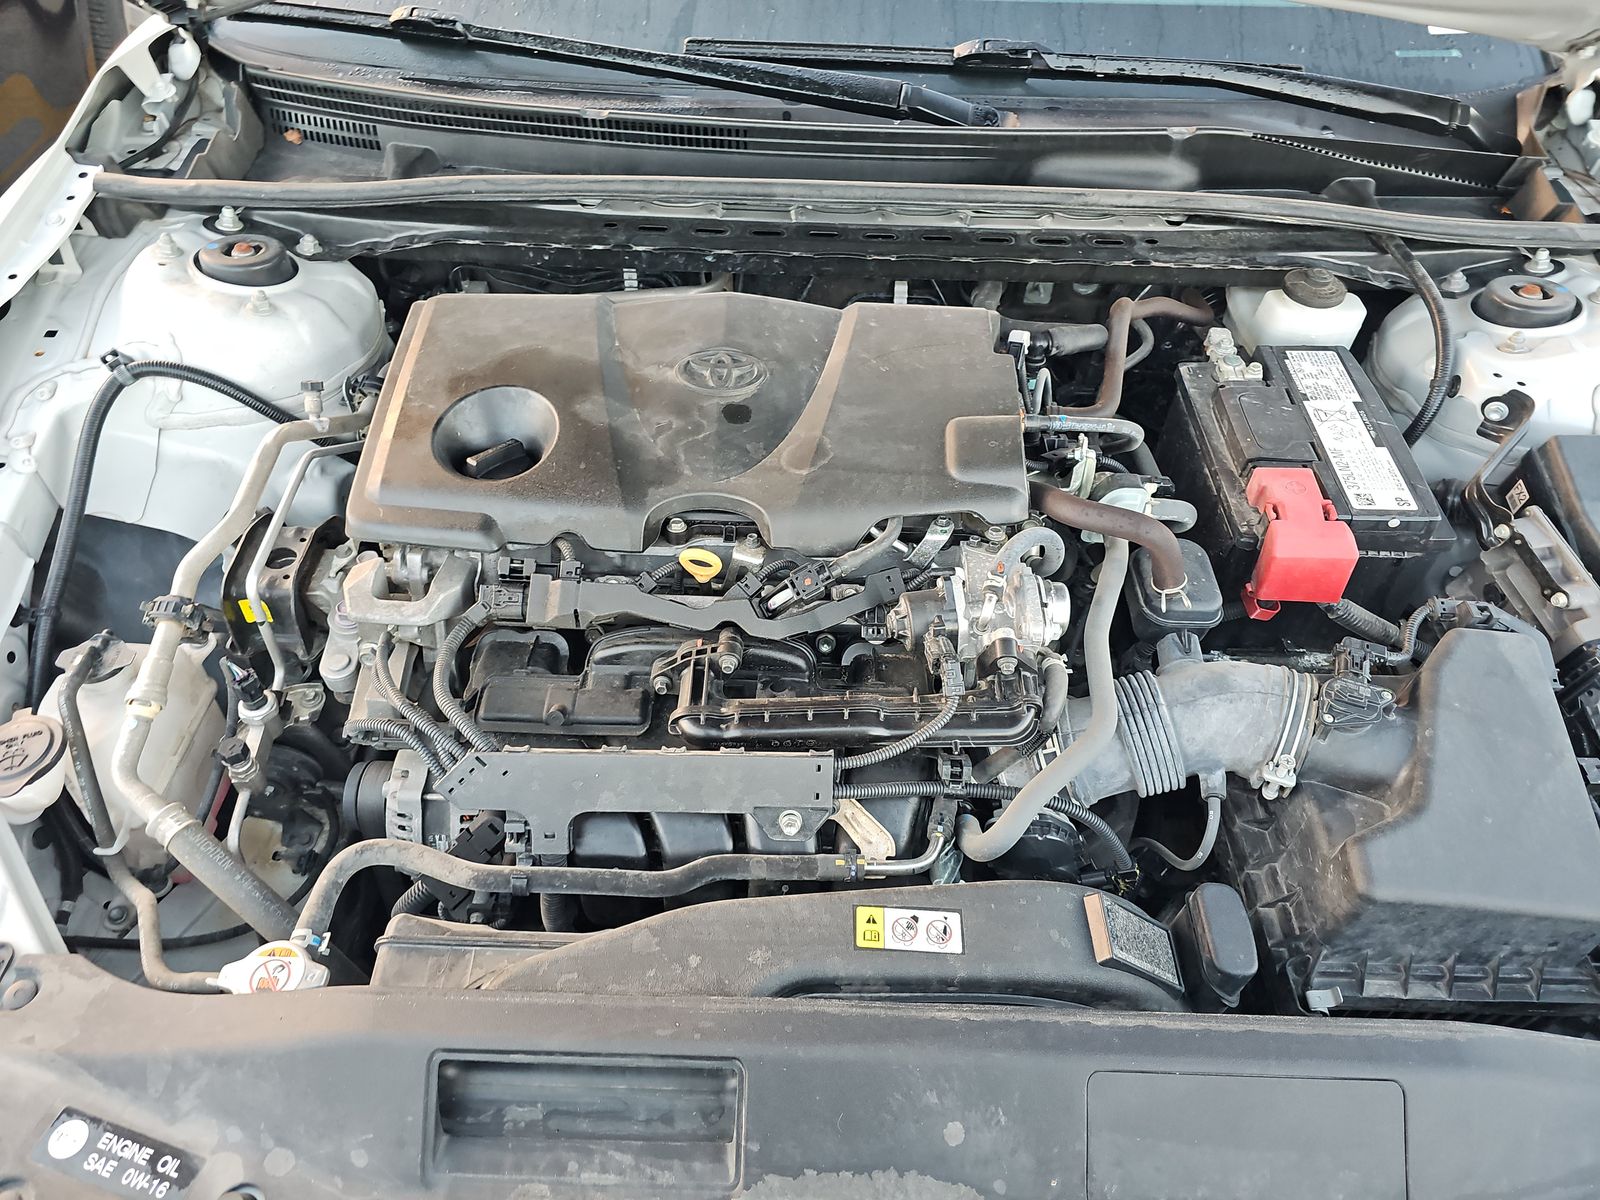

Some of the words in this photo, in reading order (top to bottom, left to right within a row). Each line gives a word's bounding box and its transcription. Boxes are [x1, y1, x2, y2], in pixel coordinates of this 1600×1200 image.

[83, 1153, 118, 1178] SAE
[121, 1168, 170, 1199] 0W-16
[97, 1132, 154, 1165] ENGINE
[157, 1155, 181, 1178] OIL
